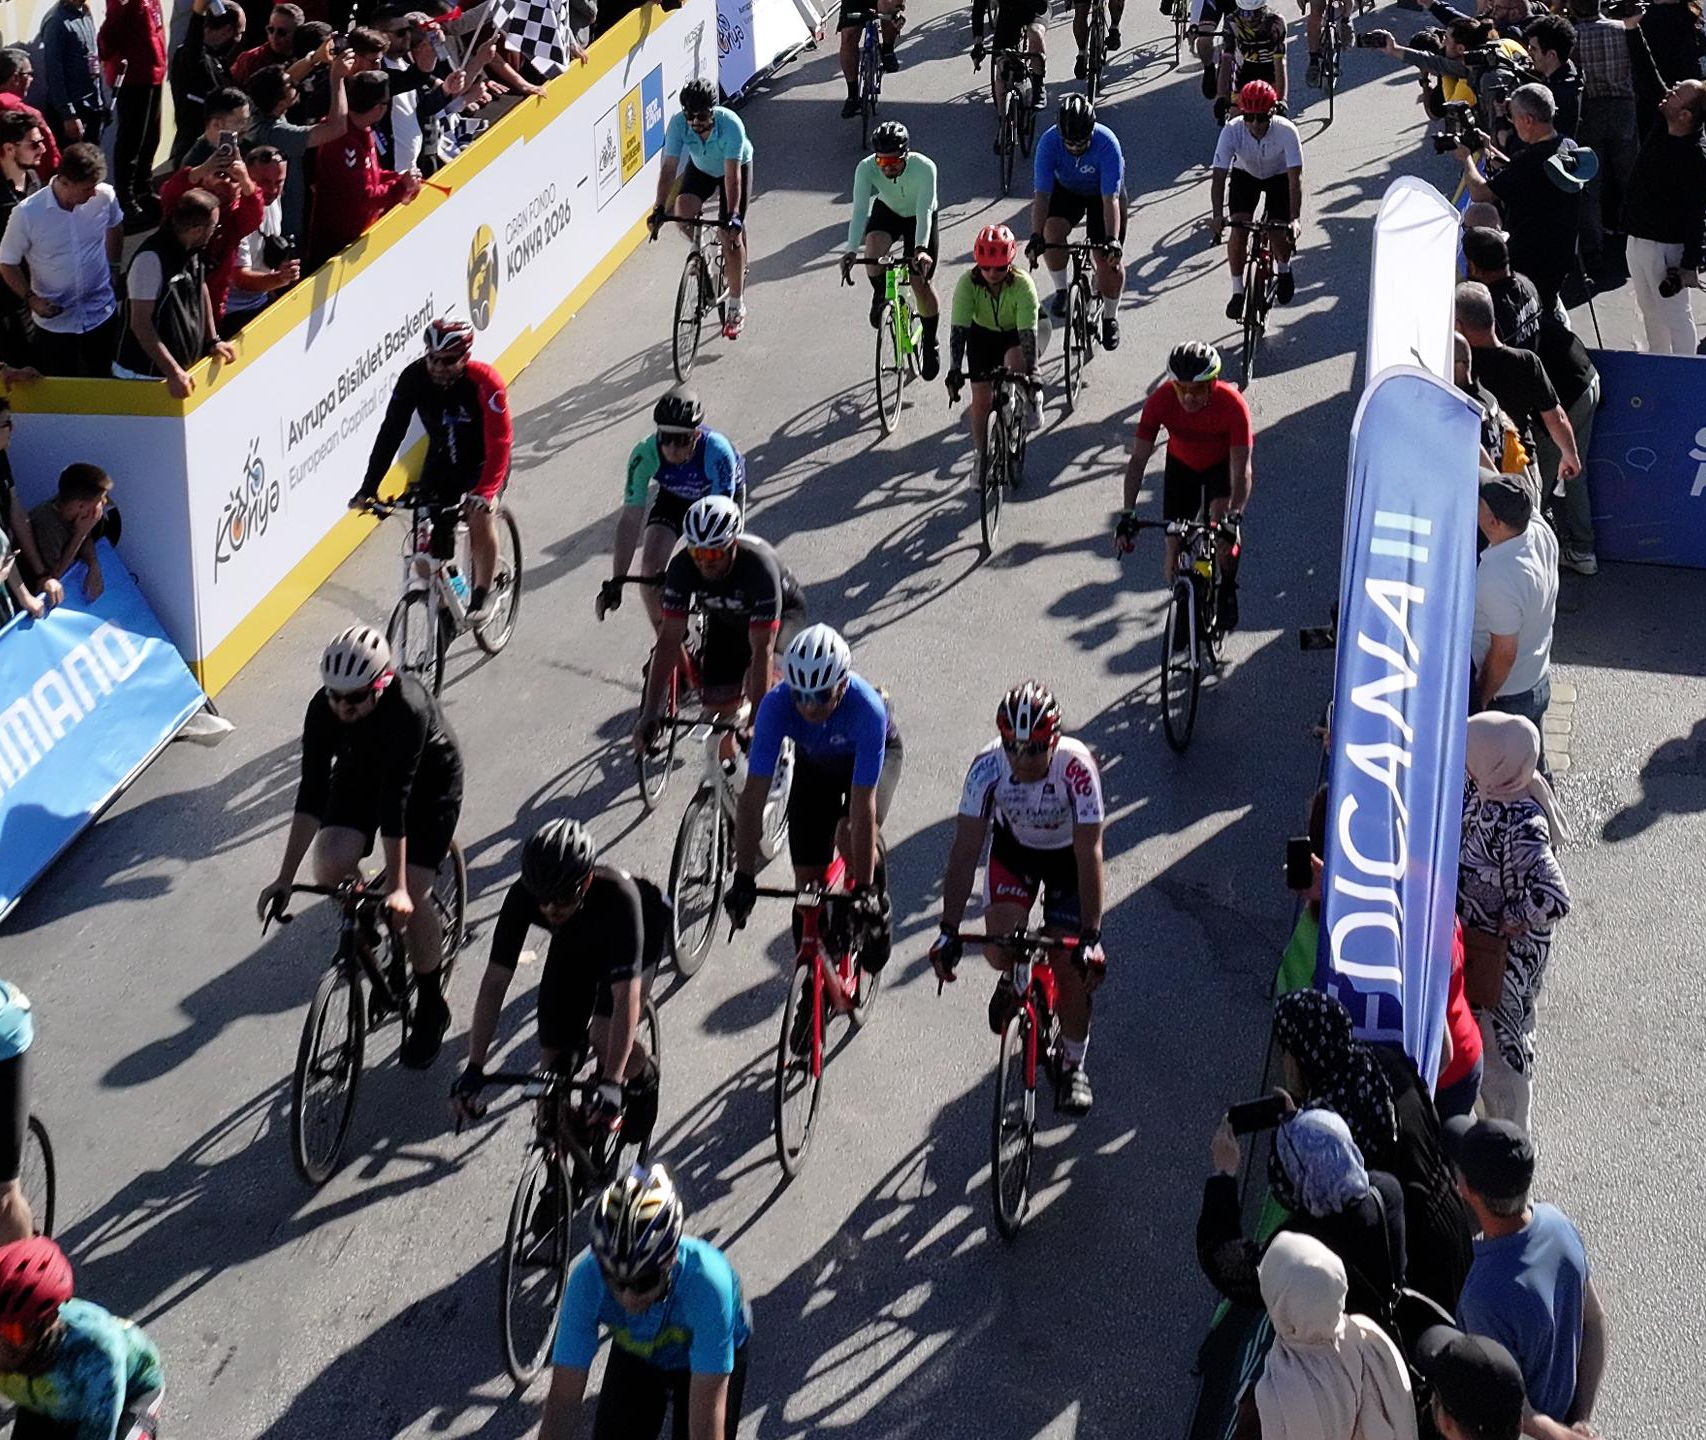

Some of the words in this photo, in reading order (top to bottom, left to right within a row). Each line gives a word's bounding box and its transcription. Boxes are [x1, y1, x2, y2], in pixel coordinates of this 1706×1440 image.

[504, 209, 530, 244] GRAN
[530, 182, 556, 224] FONDO
[507, 227, 543, 282] KONYA
[545, 198, 572, 248] 2026
[287, 391, 336, 452] Avrupa
[337, 346, 384, 409] Bisiklet
[384, 292, 434, 362] Başkenti
[290, 432, 340, 491] European
[340, 392, 378, 446] Capital
